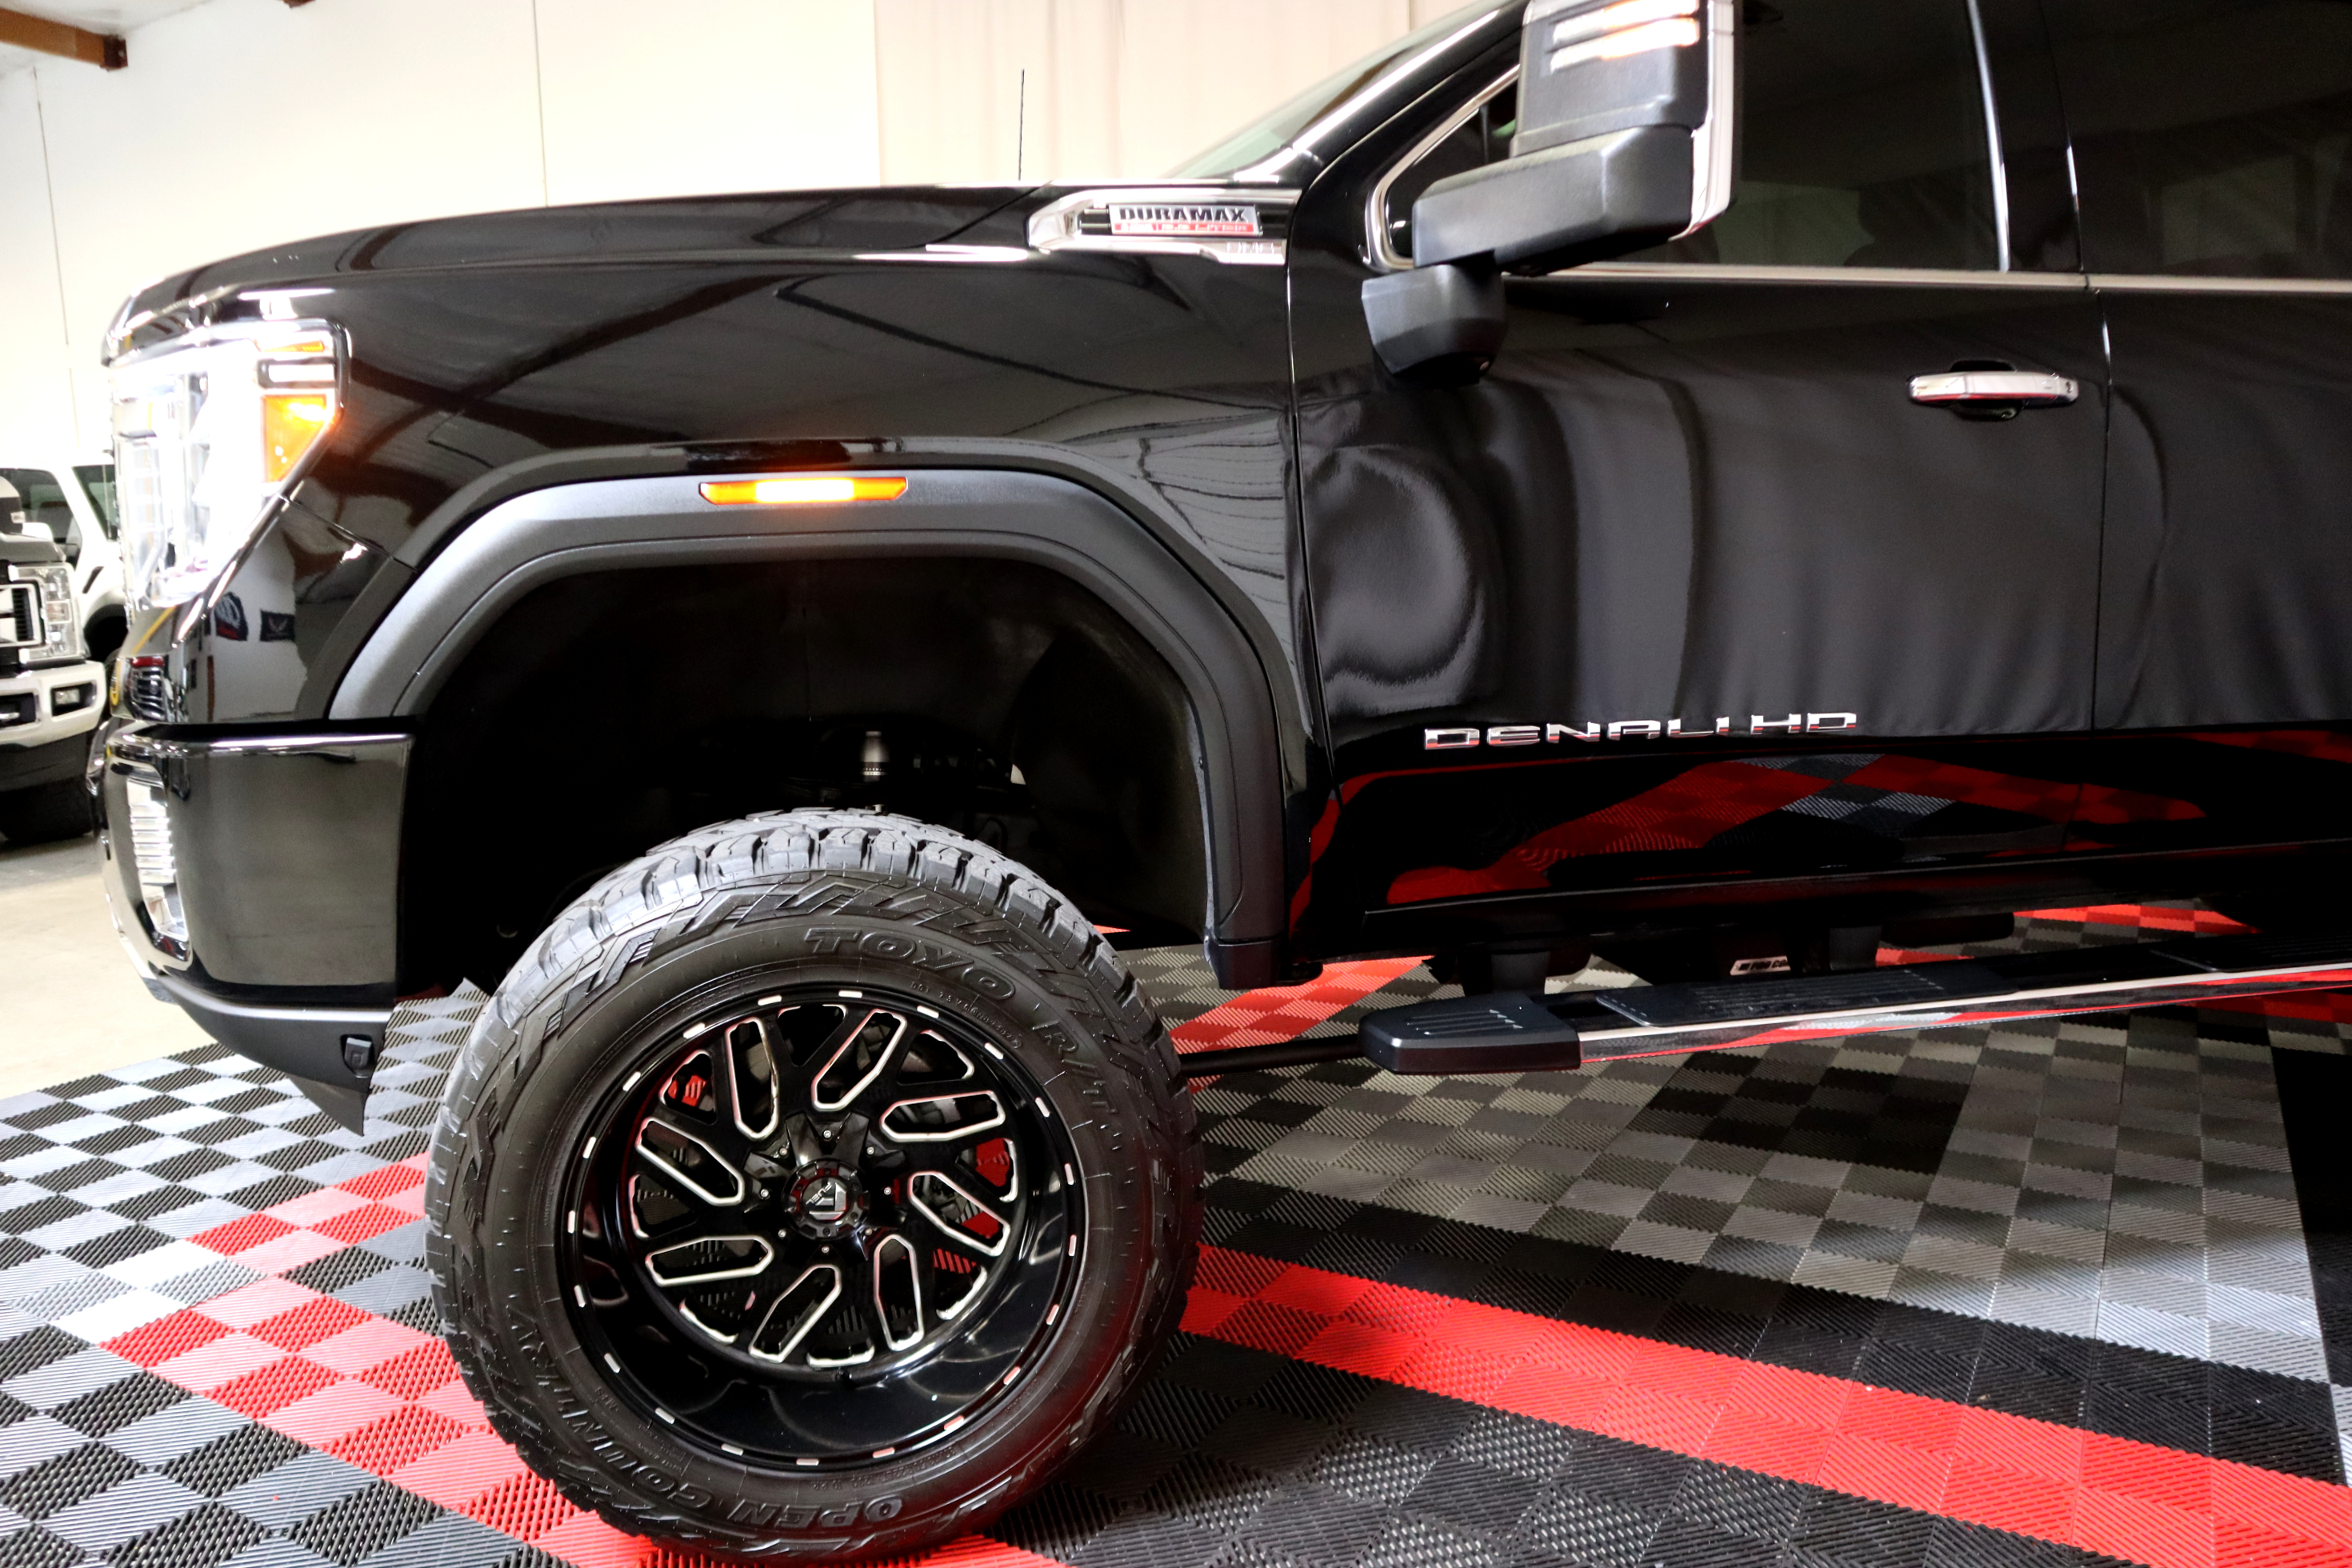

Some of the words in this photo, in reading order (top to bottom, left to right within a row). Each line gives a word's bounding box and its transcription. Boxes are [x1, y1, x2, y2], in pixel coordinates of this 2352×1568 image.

[1119, 206, 1249, 222] DURAMAX
[1424, 715, 1730, 750] DENALI
[1750, 712, 1857, 735] HD
[803, 926, 1016, 1001] TOYO
[806, 1181, 833, 1206] FUEL
[726, 1494, 904, 1529] OPEN
